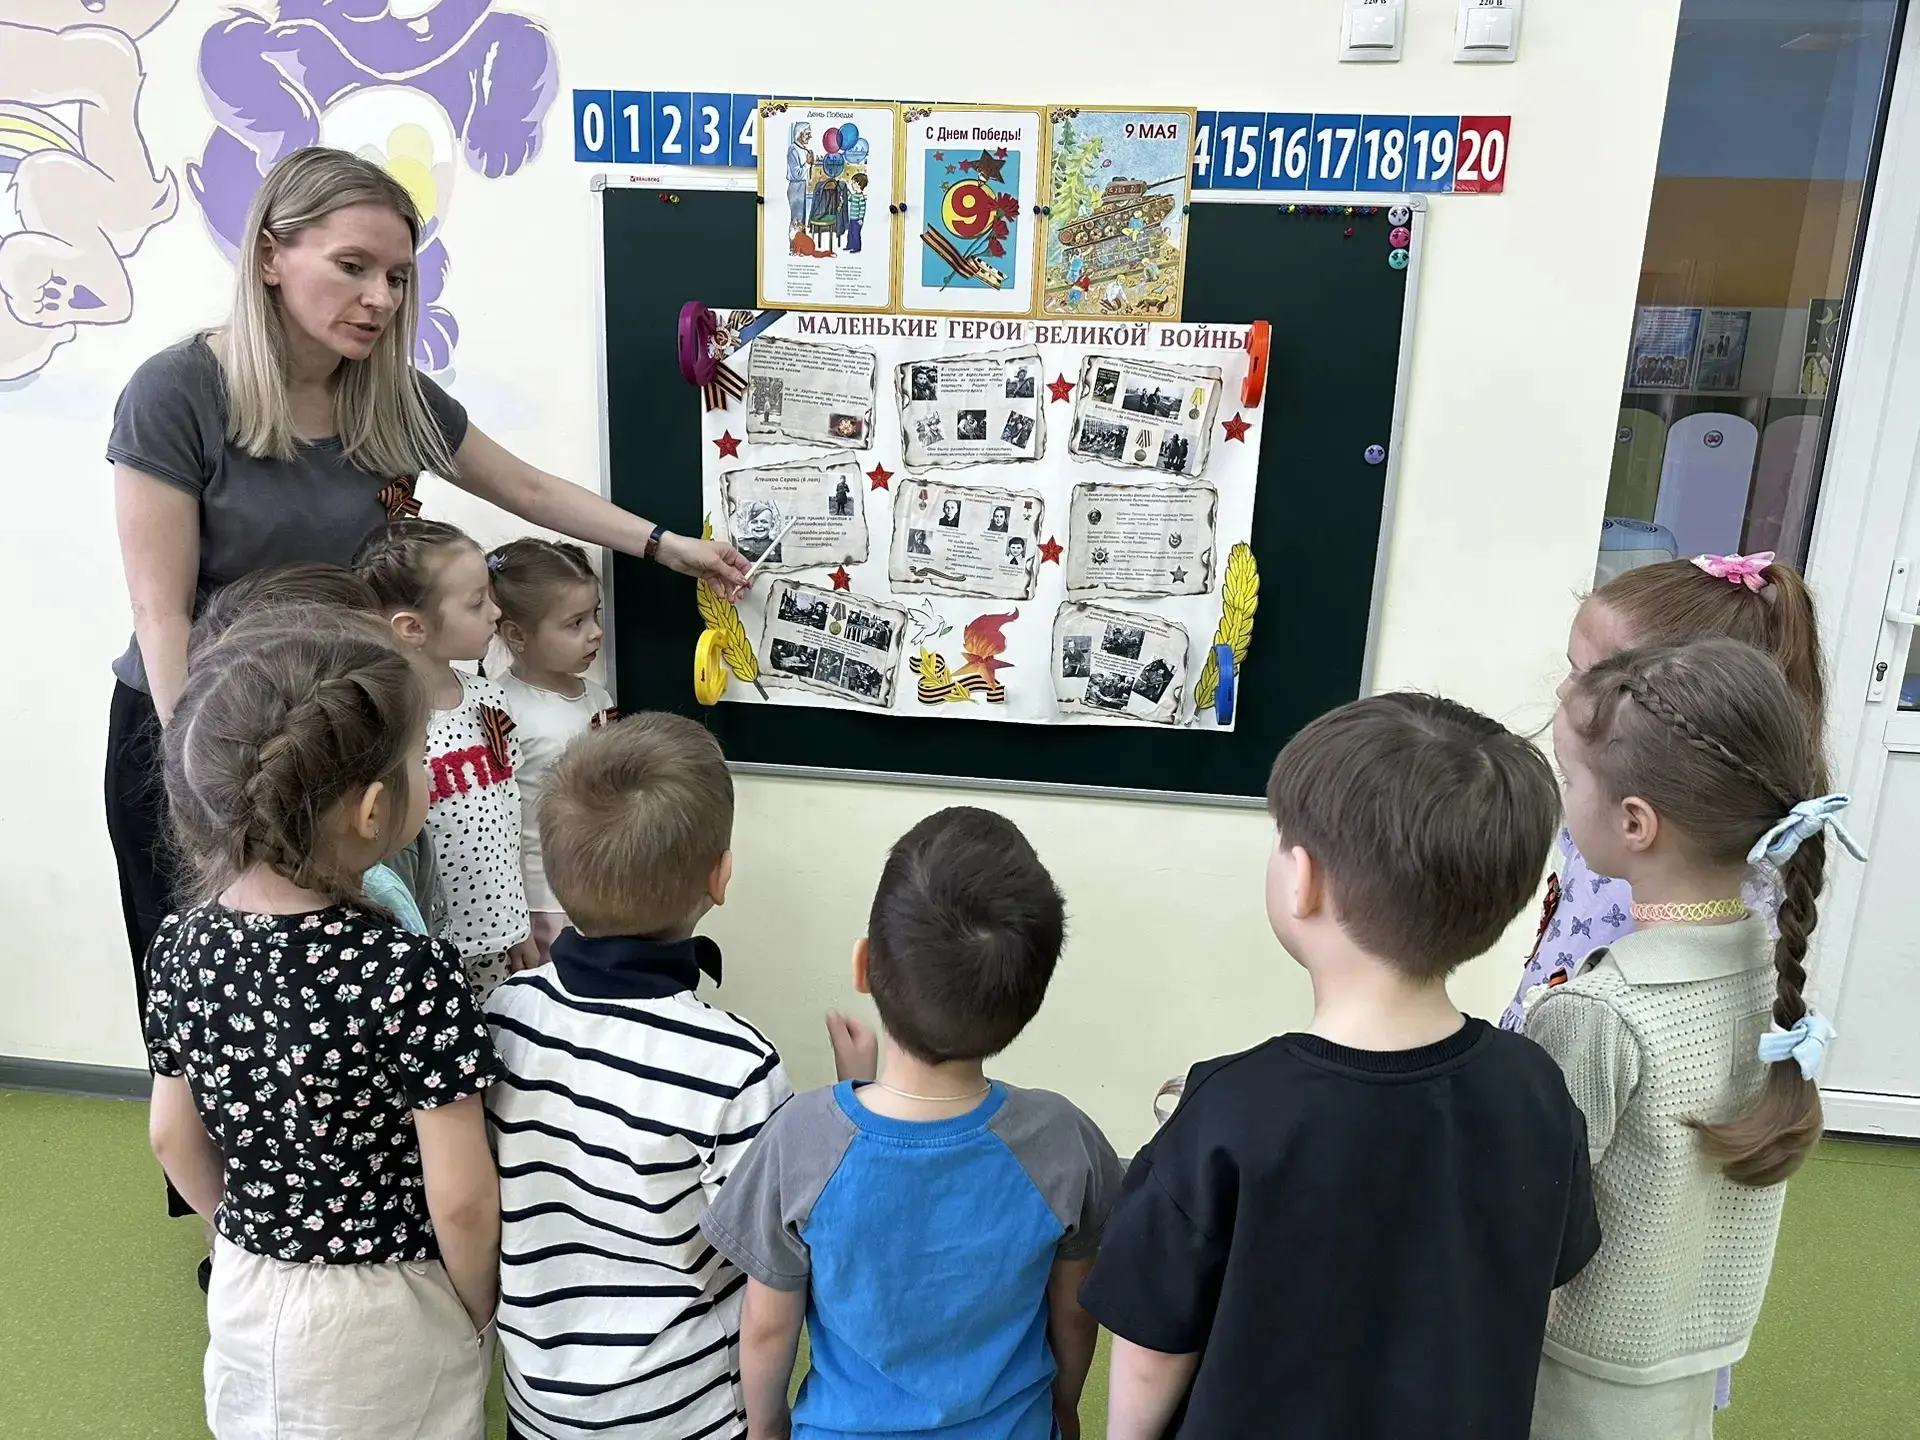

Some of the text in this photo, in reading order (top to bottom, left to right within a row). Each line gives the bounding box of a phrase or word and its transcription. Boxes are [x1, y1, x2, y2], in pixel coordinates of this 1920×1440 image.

[583, 102, 604, 152] 0
[622, 104, 640, 153] 1
[661, 105, 682, 153] 2
[700, 105, 720, 154] 3
[926, 126, 1021, 142] С Днем Победы!
[1125, 124, 1177, 139] 9 МАЯ
[1220, 126, 1259, 177] 15
[1269, 127, 1307, 179] 16
[1317, 128, 1356, 179] 17
[1364, 129, 1405, 180] 18
[1413, 129, 1454, 181] 19
[1457, 129, 1505, 181] 20
[951, 184, 991, 239] 9
[798, 316, 1249, 349] МАЛЕНЬКИЕ ГЕРОИ ВЕЛИКОЙ ВОЙНЫ
